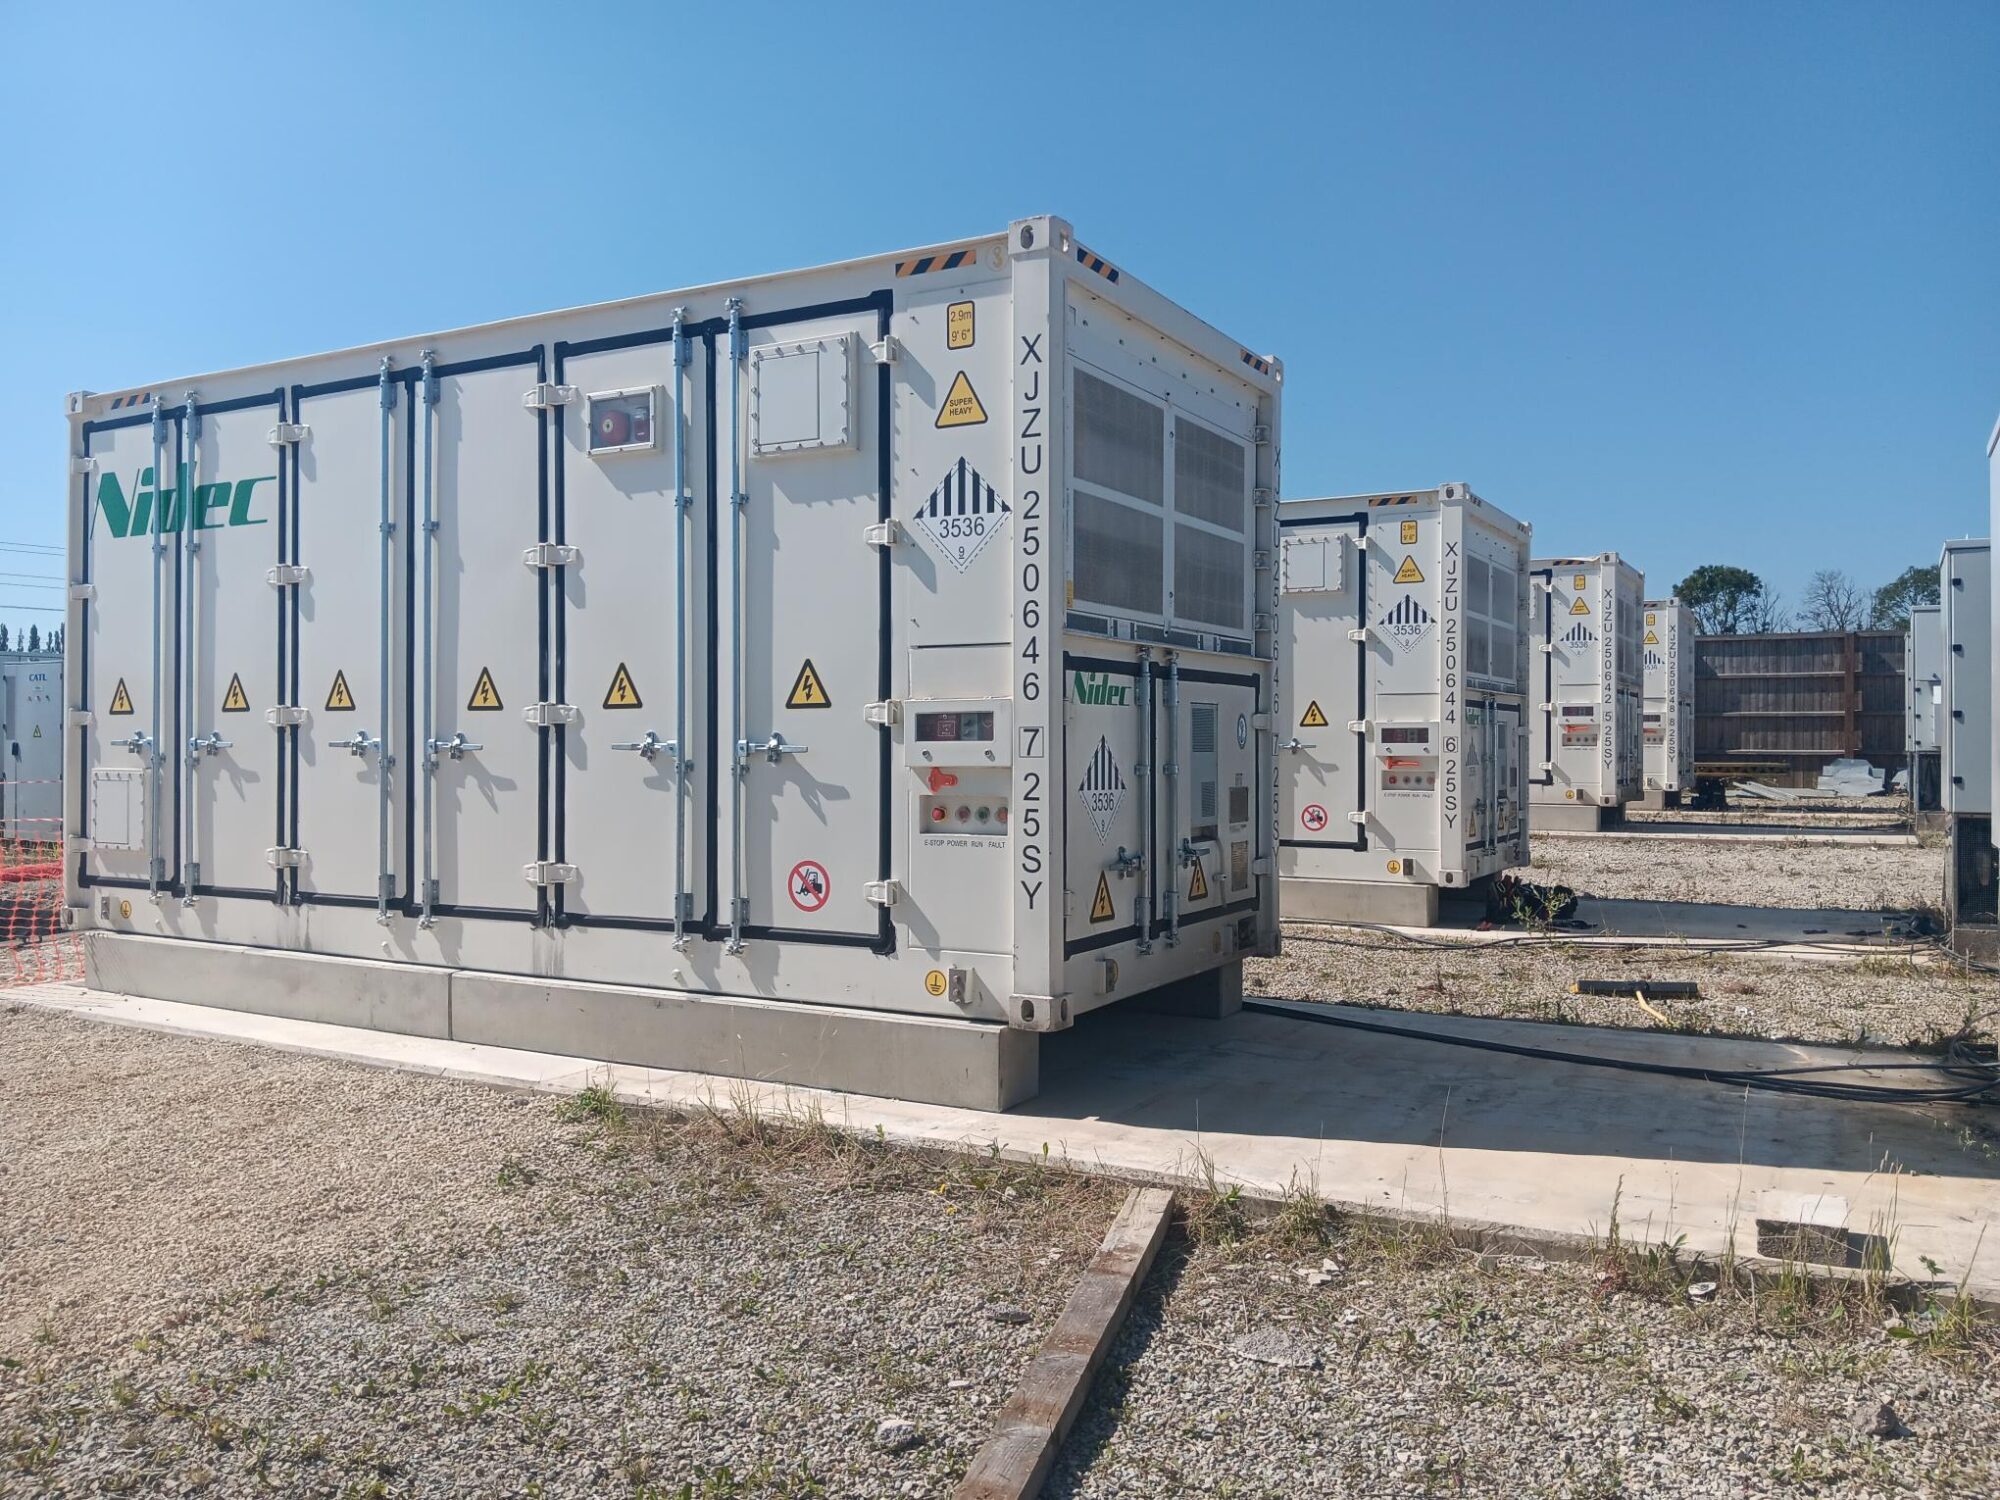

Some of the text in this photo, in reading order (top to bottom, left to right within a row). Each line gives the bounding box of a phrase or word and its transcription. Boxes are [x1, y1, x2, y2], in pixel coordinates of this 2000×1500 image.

[951, 310, 972, 322] 2.9m
[950, 397, 973, 407] SUPER
[950, 407, 973, 416] HEAVY
[90, 461, 277, 541] Nidec
[939, 516, 985, 539] 3536
[958, 546, 965, 559] 9
[1021, 333, 1043, 910] XJZU 250646 7 25SY
[1394, 625, 1421, 635] 3536
[29, 673, 47, 681] CATL
[1445, 541, 1458, 829] XJZU 250644 6 25SY
[1604, 589, 1612, 769] XJZU 250642 5 25SY
[1072, 671, 1132, 706] Nidec
[1092, 792, 1115, 811] 3536
[924, 839, 945, 847] E-STOP
[988, 841, 1006, 849] FAULT
